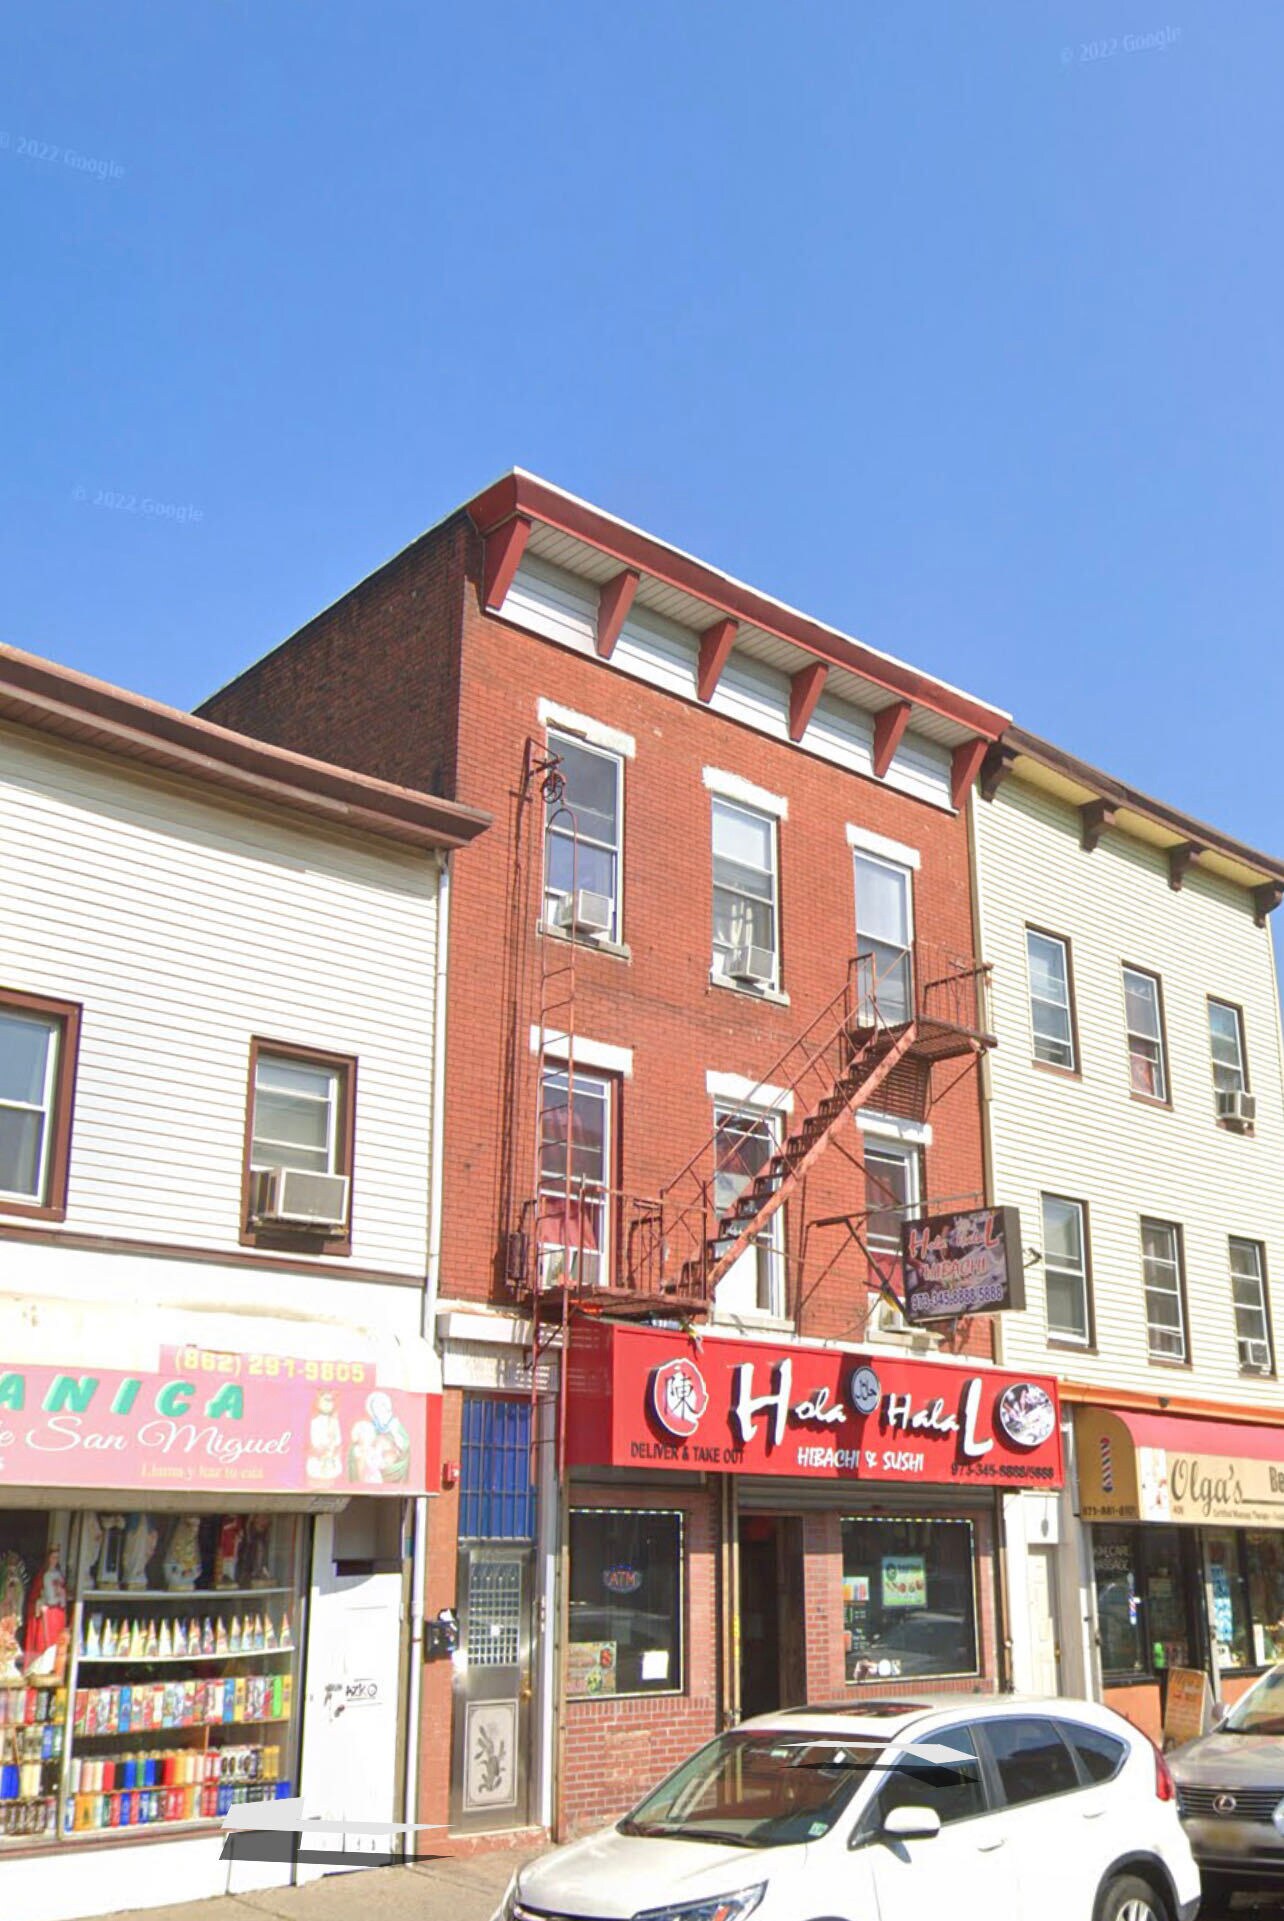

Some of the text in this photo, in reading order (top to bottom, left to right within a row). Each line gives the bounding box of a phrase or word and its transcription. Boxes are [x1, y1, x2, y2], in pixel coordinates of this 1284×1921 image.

[175, 1347, 241, 1376] (862)
[737, 1358, 994, 1456] Hola HalaL
[25, 1415, 128, 1451] San
[138, 1419, 292, 1464] Miguel
[630, 1441, 679, 1460] DELIVER
[693, 1446, 720, 1463] TAKE
[723, 1449, 745, 1465] OUT
[797, 1446, 925, 1472] HIBACHI & SUSHI
[1170, 1458, 1243, 1518] Olga's
[610, 1571, 636, 1586] ATM
